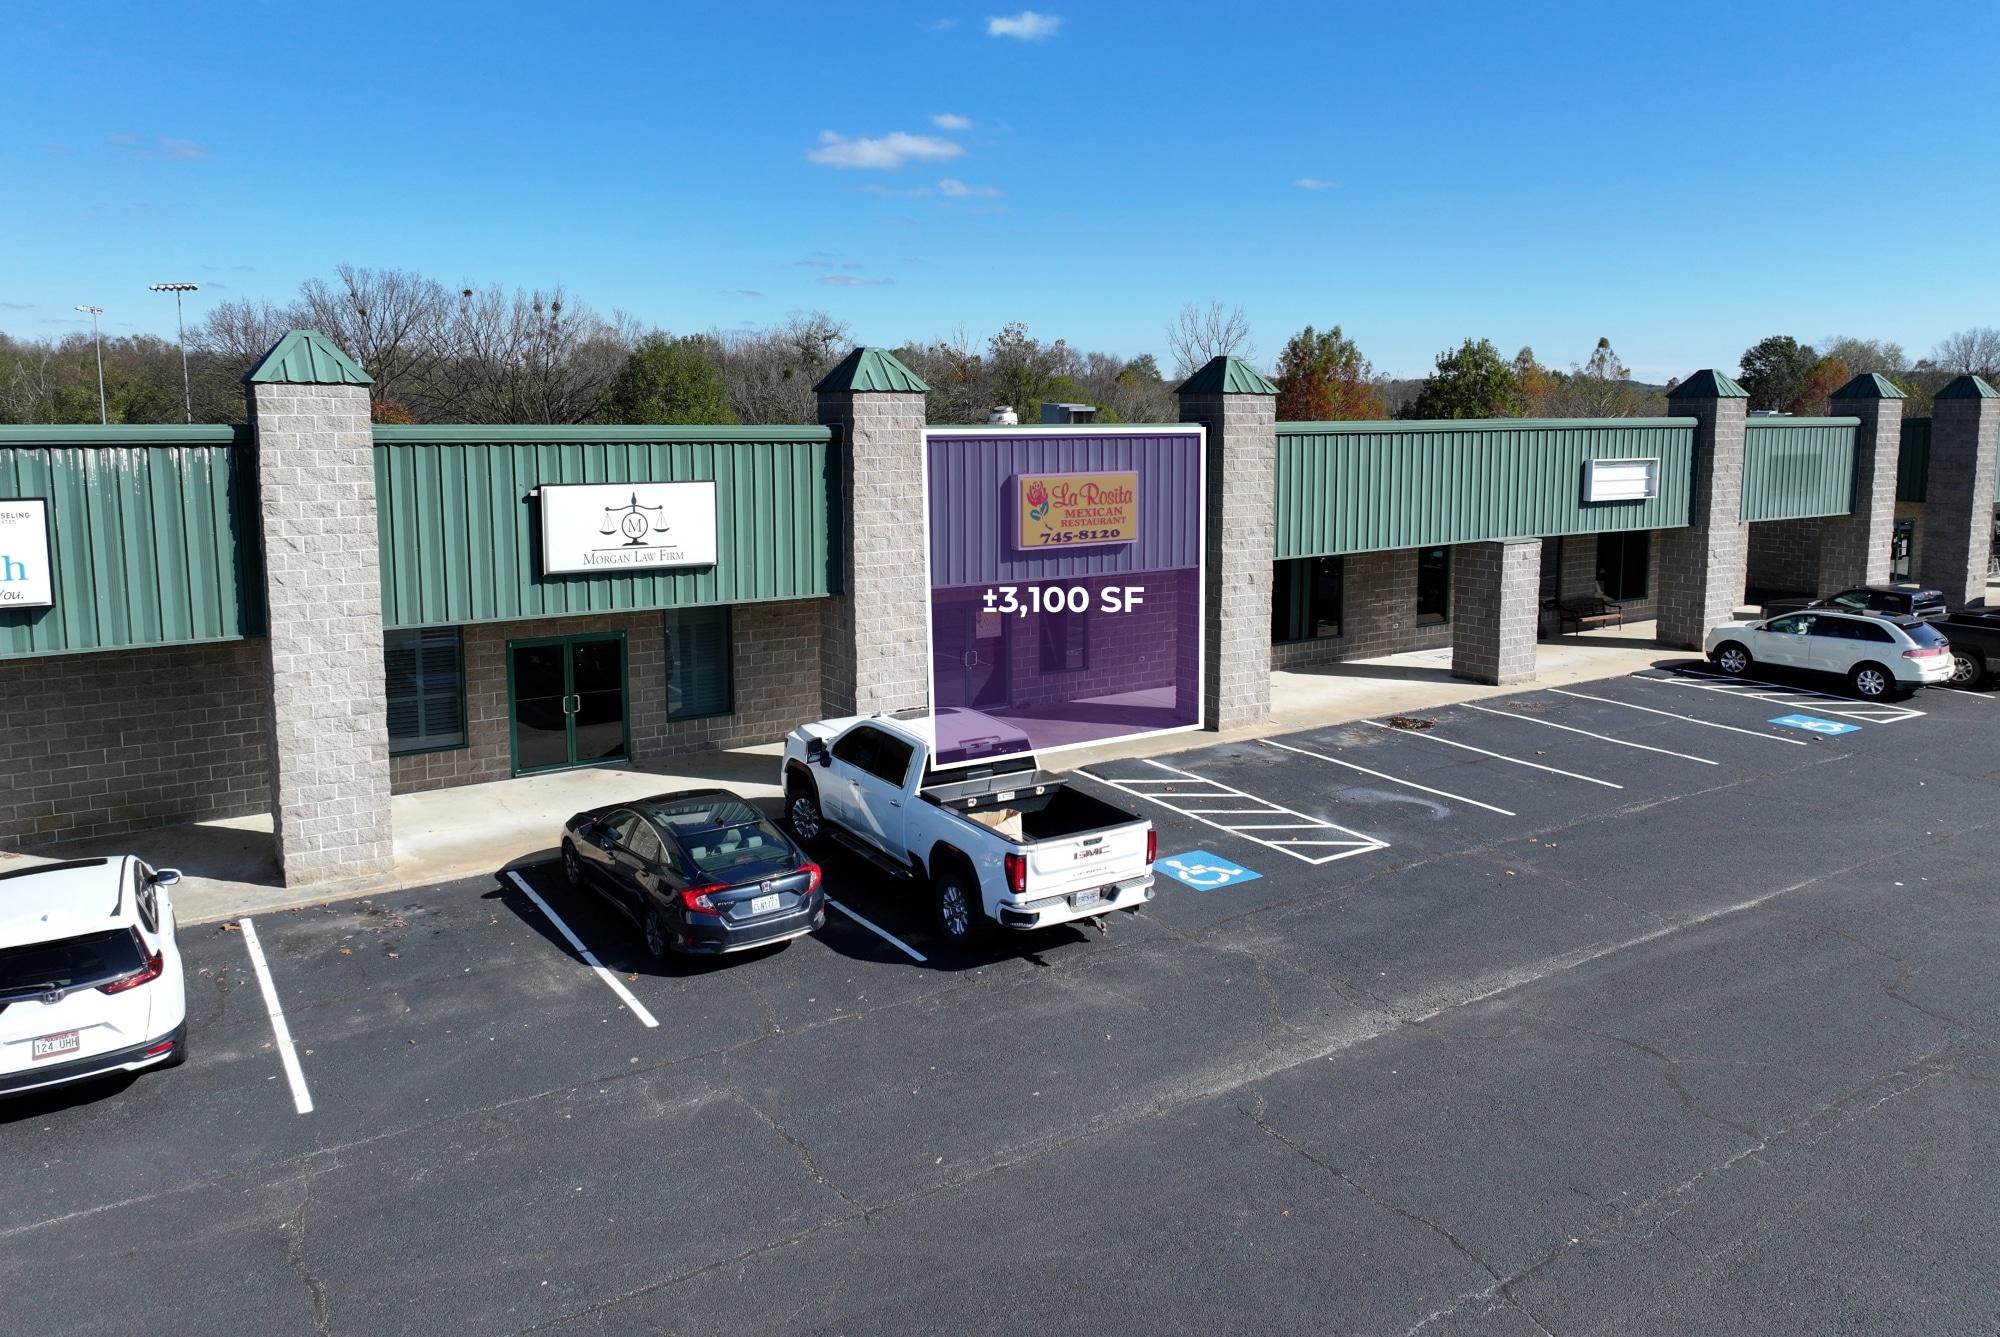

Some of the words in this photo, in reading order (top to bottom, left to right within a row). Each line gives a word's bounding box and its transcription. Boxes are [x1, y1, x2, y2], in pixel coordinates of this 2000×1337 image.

[1052, 482, 1078, 509] La
[1079, 482, 1133, 506] Rosita
[1064, 506, 1123, 519] MEXICAN
[628, 518, 643, 533] M
[1061, 516, 1127, 528] RESTAURANT
[1040, 528, 1121, 544] 745-8120
[1073, 845, 1111, 860] GMC
[36, 1042, 53, 1054] 124
